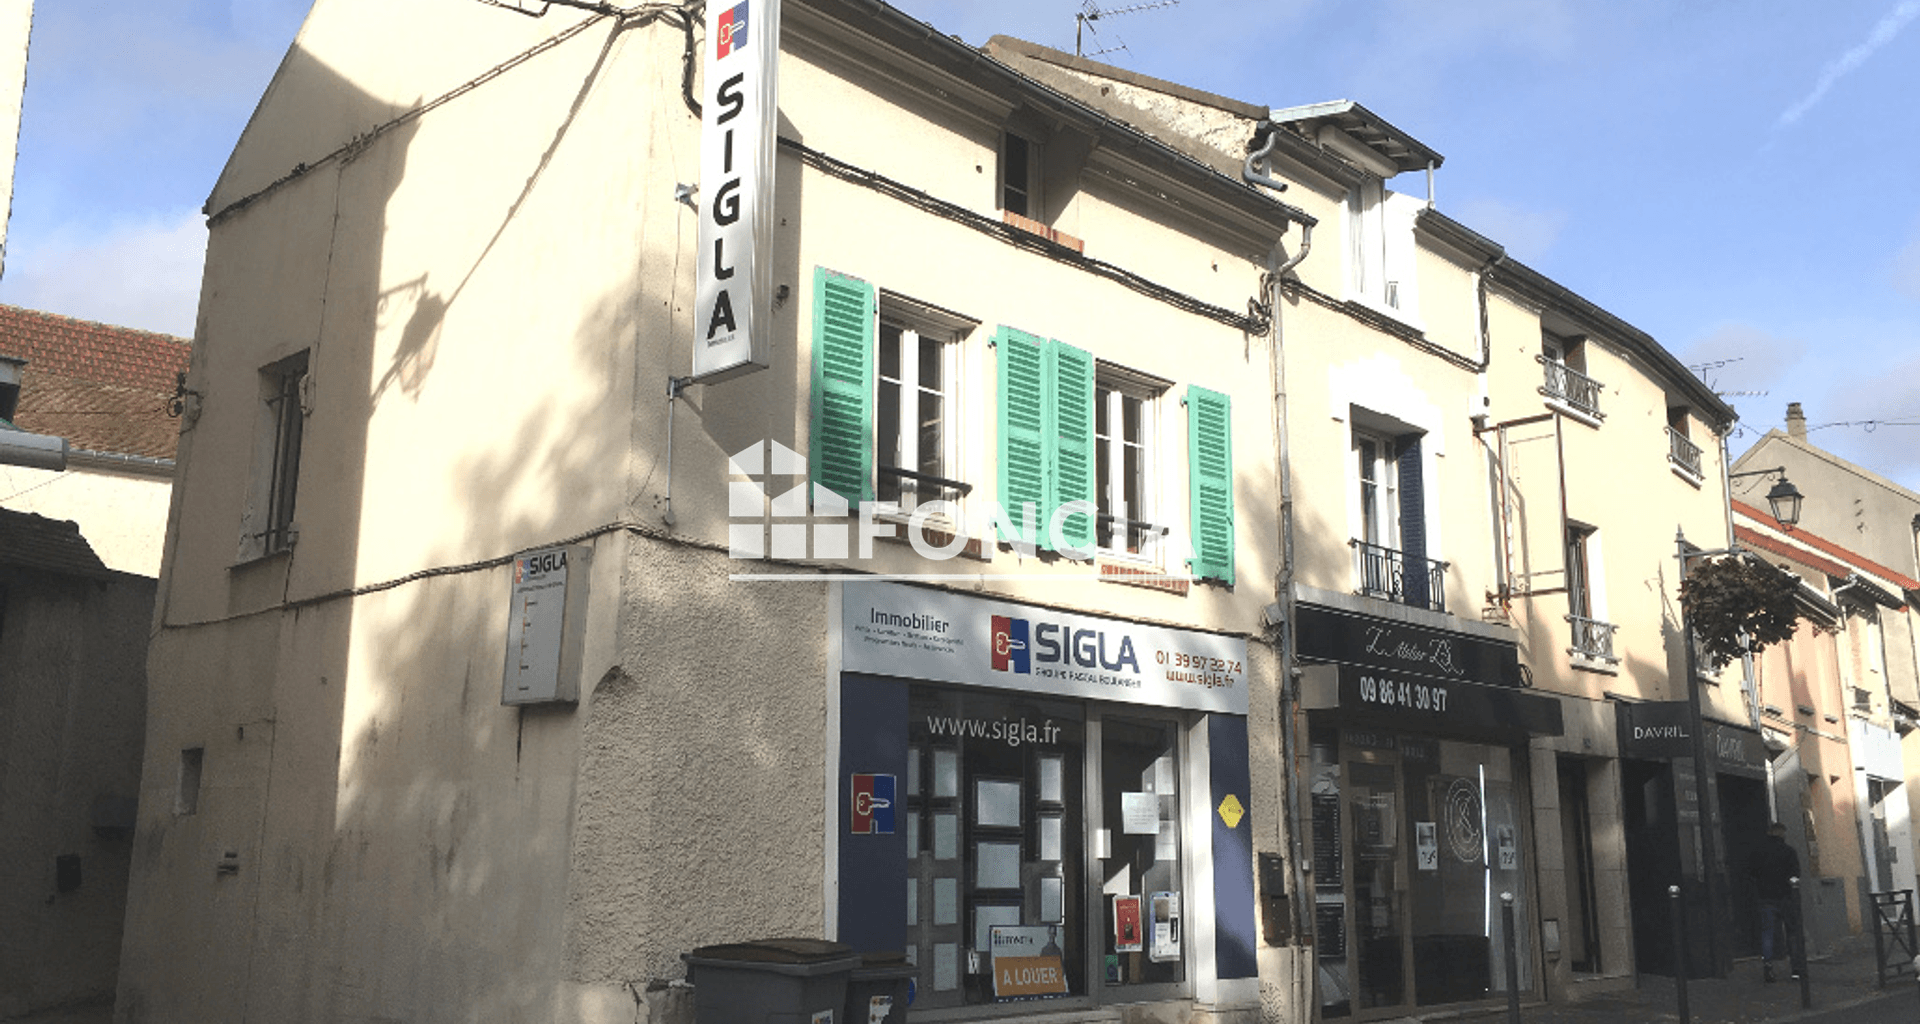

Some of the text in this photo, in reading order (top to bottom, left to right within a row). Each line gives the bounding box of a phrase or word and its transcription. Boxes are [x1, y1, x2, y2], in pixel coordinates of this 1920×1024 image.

[707, 72, 744, 340] SIGLA
[530, 552, 567, 575] SIGLA
[871, 607, 949, 633] Immobilier
[1035, 622, 1140, 674] SIGLA
[1155, 650, 1242, 674] 01 39 97 22 74
[1166, 670, 1235, 688] www.sigla.fr
[1360, 676, 1447, 712] 09 86 41 30 97
[927, 715, 1061, 747] www.sigla.fr
[1634, 727, 1689, 739] DAVRIL
[1003, 967, 1058, 986] A LOUER
